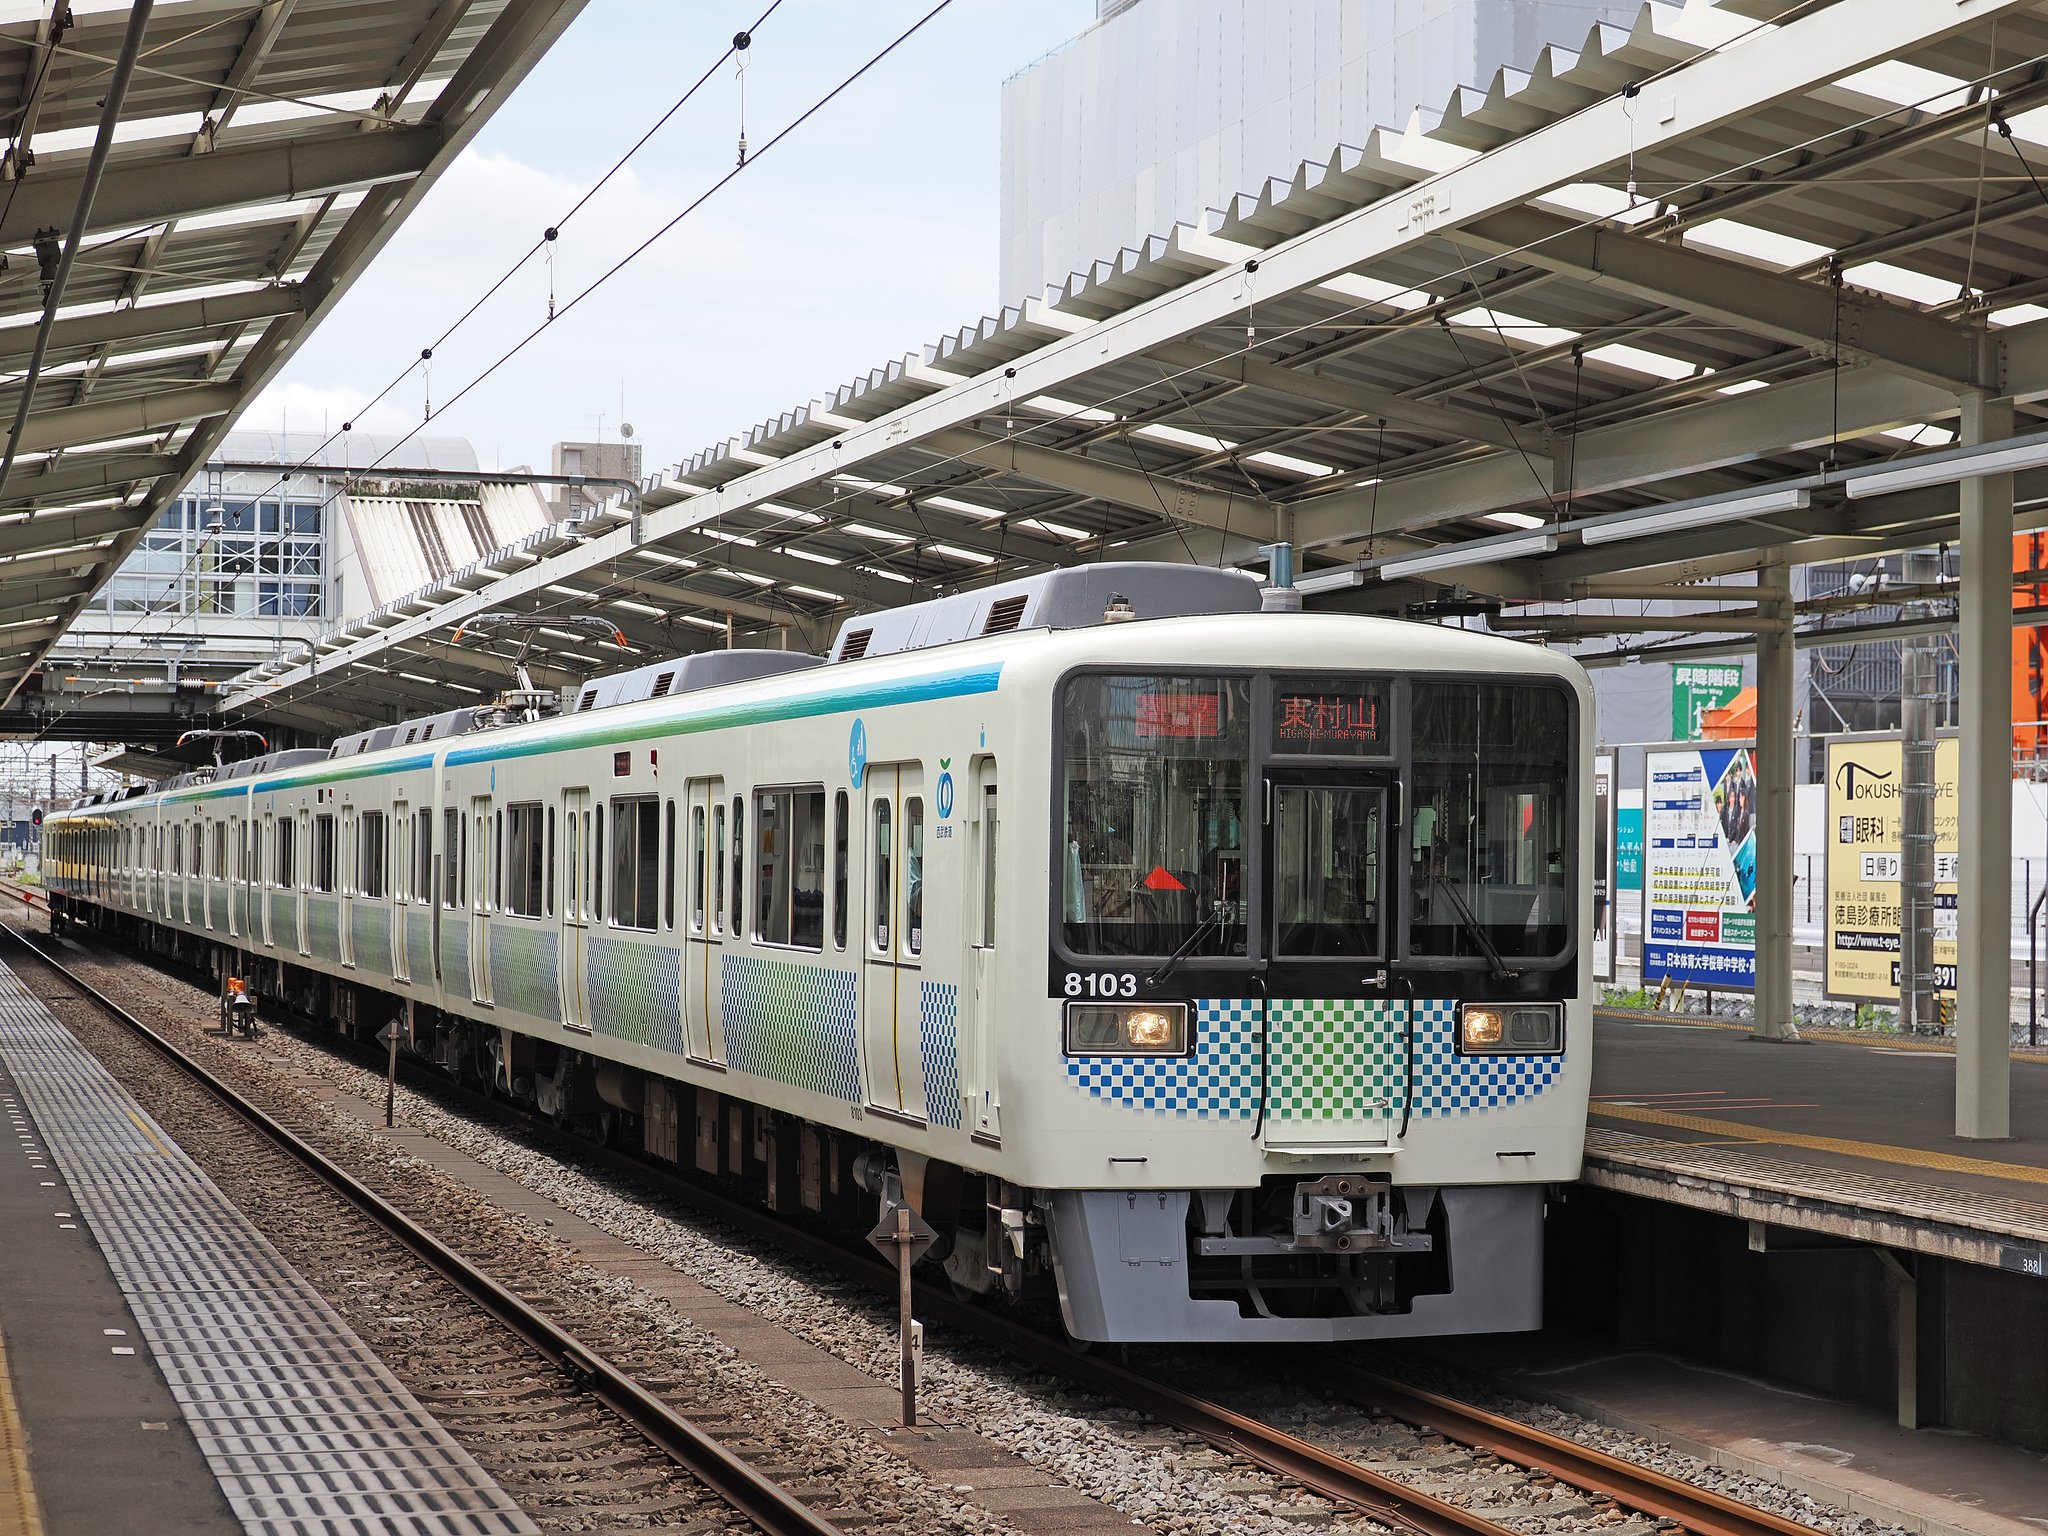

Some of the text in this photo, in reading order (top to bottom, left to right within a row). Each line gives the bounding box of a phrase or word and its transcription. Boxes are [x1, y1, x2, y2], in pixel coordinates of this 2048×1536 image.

[1676, 668, 1740, 687] 昇降階段
[1709, 688, 1724, 696] Way
[1280, 696, 1376, 729] 東村山
[1280, 729, 1377, 740] HIGASHI-MURAYAMA
[1856, 816, 1884, 843] 眼科
[1865, 857, 1898, 876] 日帰り
[1064, 973, 1137, 996] 8103
[2023, 1258, 2038, 1272] 388
